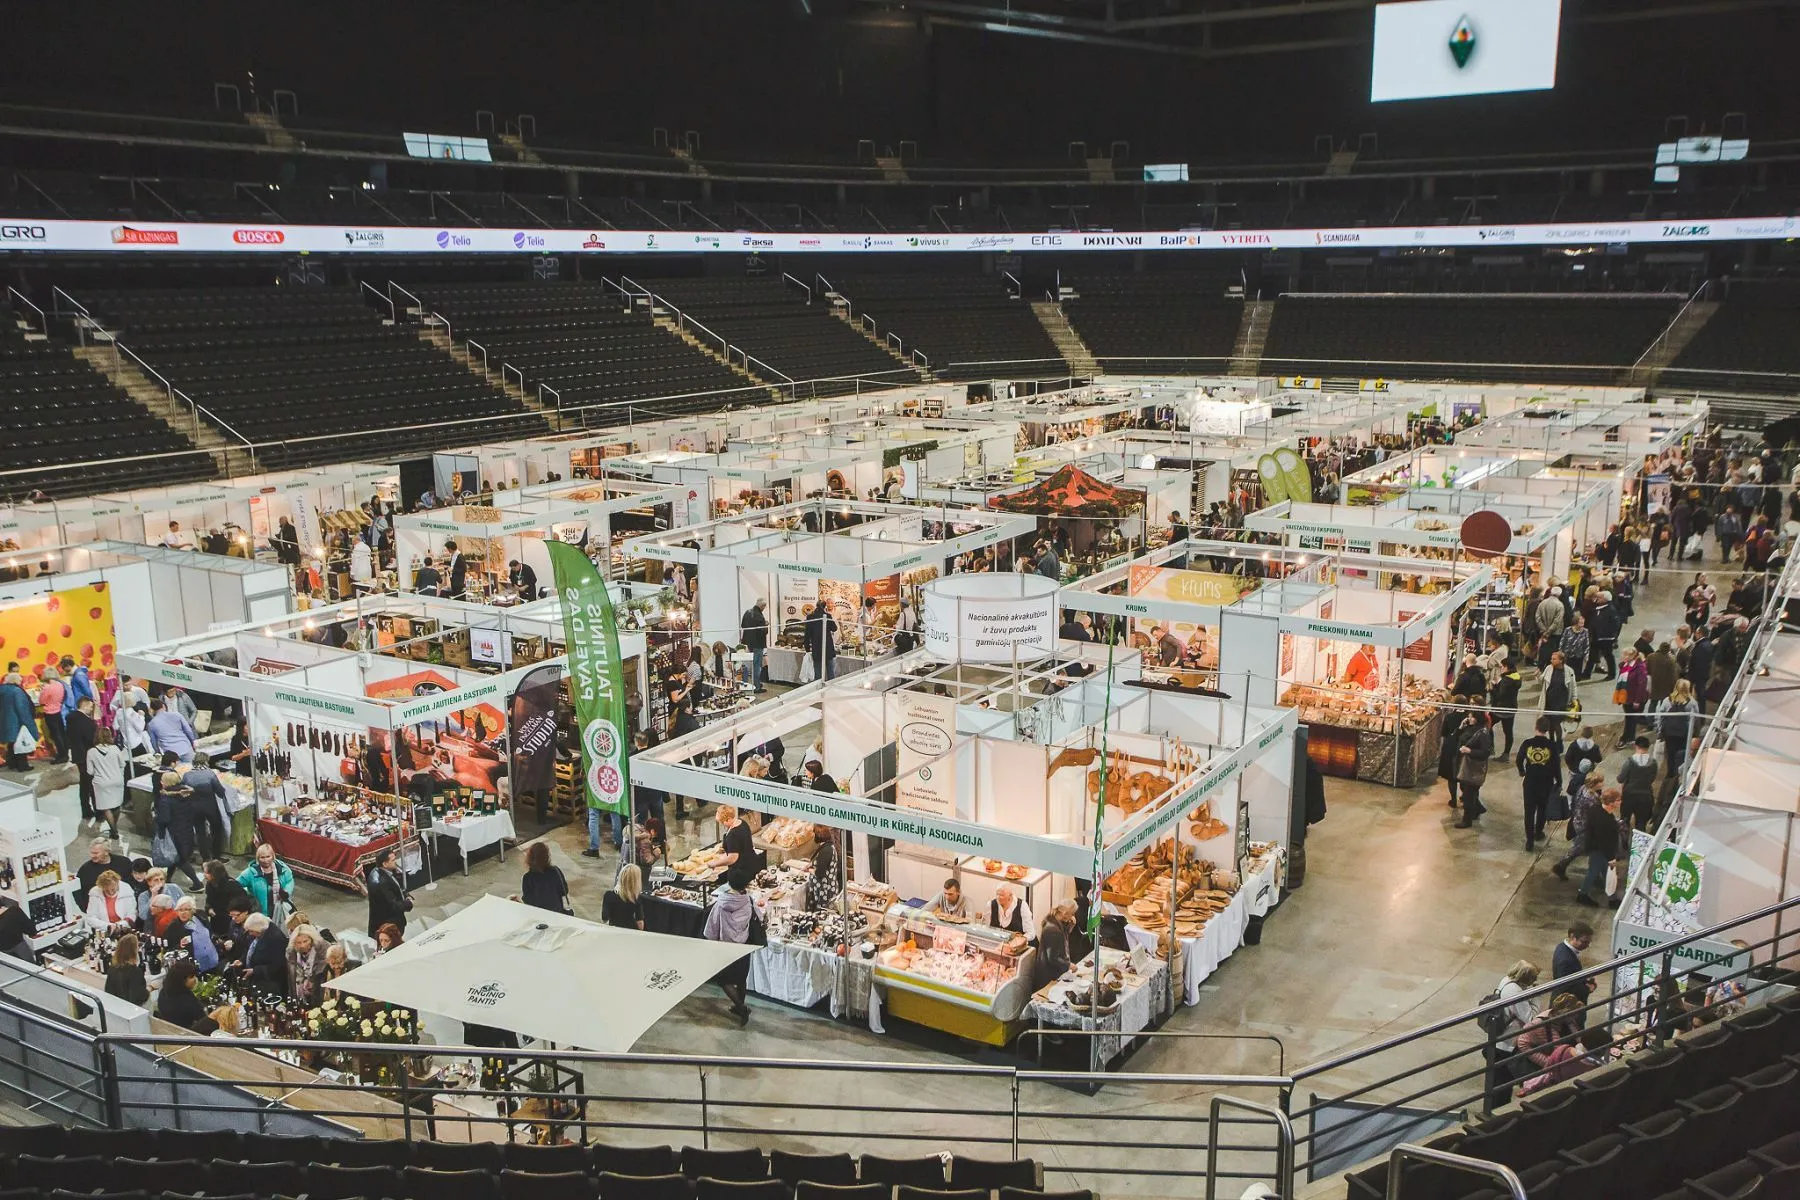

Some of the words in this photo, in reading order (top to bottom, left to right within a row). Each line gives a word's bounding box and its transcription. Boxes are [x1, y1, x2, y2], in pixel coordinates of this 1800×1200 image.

[0, 226, 46, 239] GRO
[238, 231, 281, 243] BOSCA
[1323, 234, 1360, 243] SCANDAGRA
[452, 235, 471, 247] Telia
[527, 236, 545, 247] Telia
[1222, 235, 1271, 244] VYTRITA
[1125, 604, 1148, 613] KRUMS
[967, 612, 1010, 622] Nacionalinė
[1010, 610, 1048, 621] akvakultūros
[1308, 624, 1348, 636] PRIESKONIŲ
[1350, 629, 1373, 638] NAMAI
[275, 691, 298, 704] VYTINTA
[298, 696, 324, 709] JAUTIENA
[324, 700, 355, 715] BASTURMA
[402, 703, 431, 719] VYTINTA
[432, 694, 462, 711] JAUTIENA
[463, 684, 498, 699] BASTURMA
[522, 718, 558, 756] STUDIJA
[714, 784, 751, 800] LIETUVOS
[752, 791, 788, 809] TAUTINIO
[790, 800, 827, 816] PAVELDO
[828, 807, 878, 829] GAMINTOJŲ
[880, 819, 890, 829] IR
[891, 817, 927, 839] KŪRĖJŲ
[929, 827, 984, 848] ASOCIACIJA
[1115, 837, 1137, 861] LIETUVOS
[1136, 821, 1157, 846] TAUTINIO
[1157, 809, 1176, 828] PAVELDO
[1629, 935, 1665, 949] SUP
[467, 987, 506, 999] TINGINIO
[467, 995, 498, 1006] PANTIS
